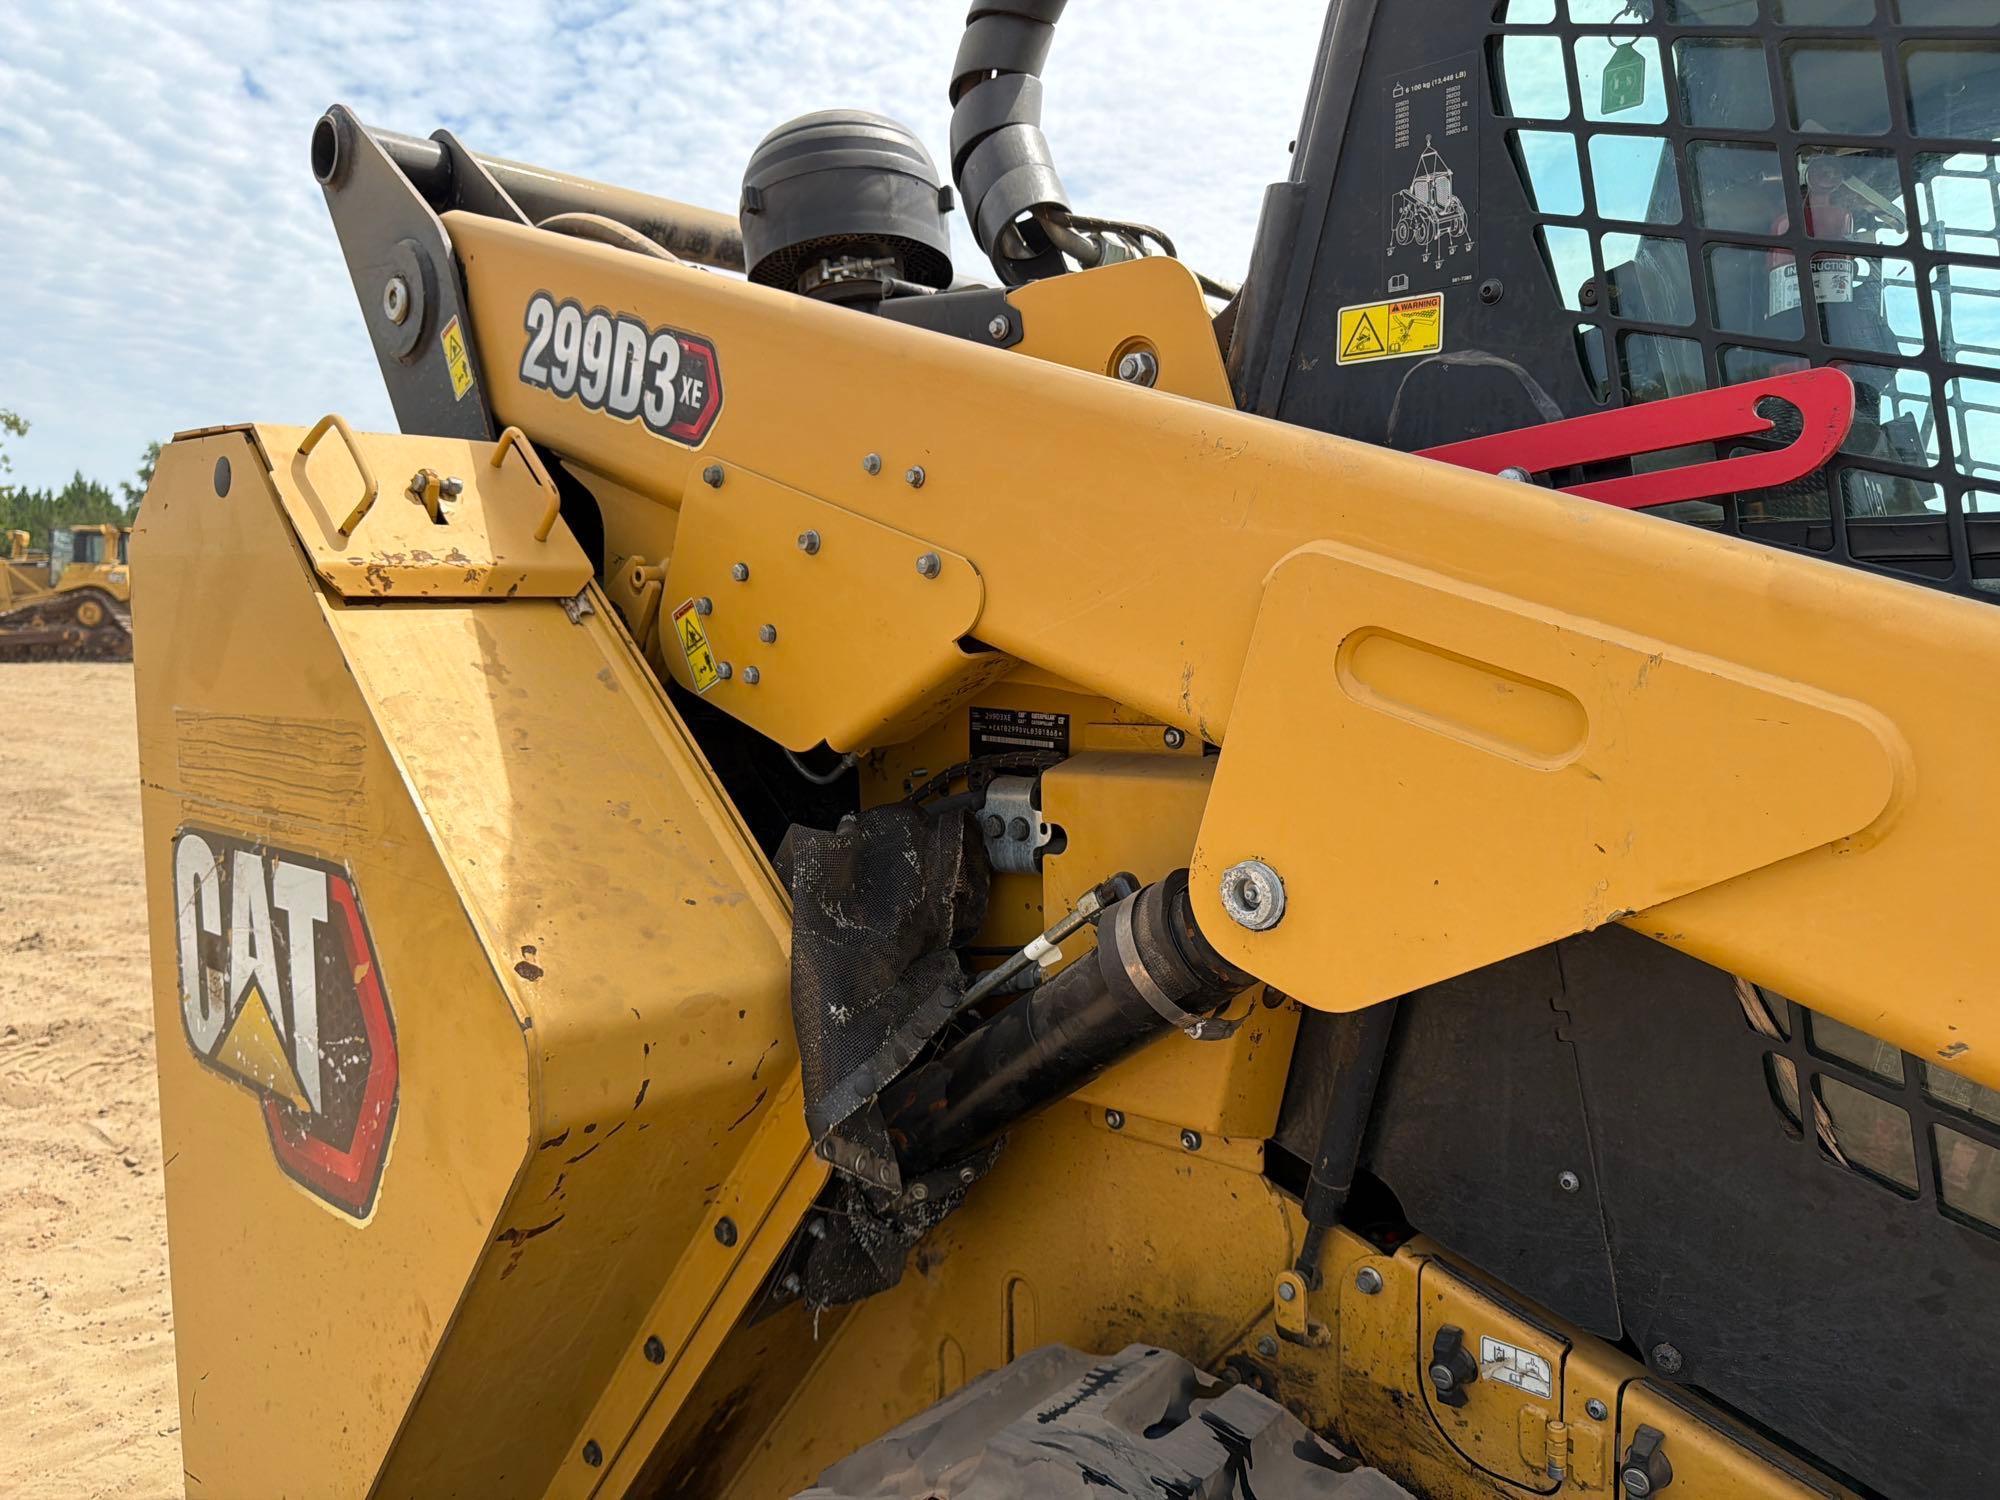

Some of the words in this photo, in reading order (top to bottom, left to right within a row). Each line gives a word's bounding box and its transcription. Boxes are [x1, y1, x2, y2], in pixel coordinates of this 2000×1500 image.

[1422, 81, 1431, 89] kg
[1401, 299, 1438, 310] WARNING
[522, 297, 680, 427] 299D3
[679, 375, 704, 409] XE
[176, 833, 329, 1115] CAT
